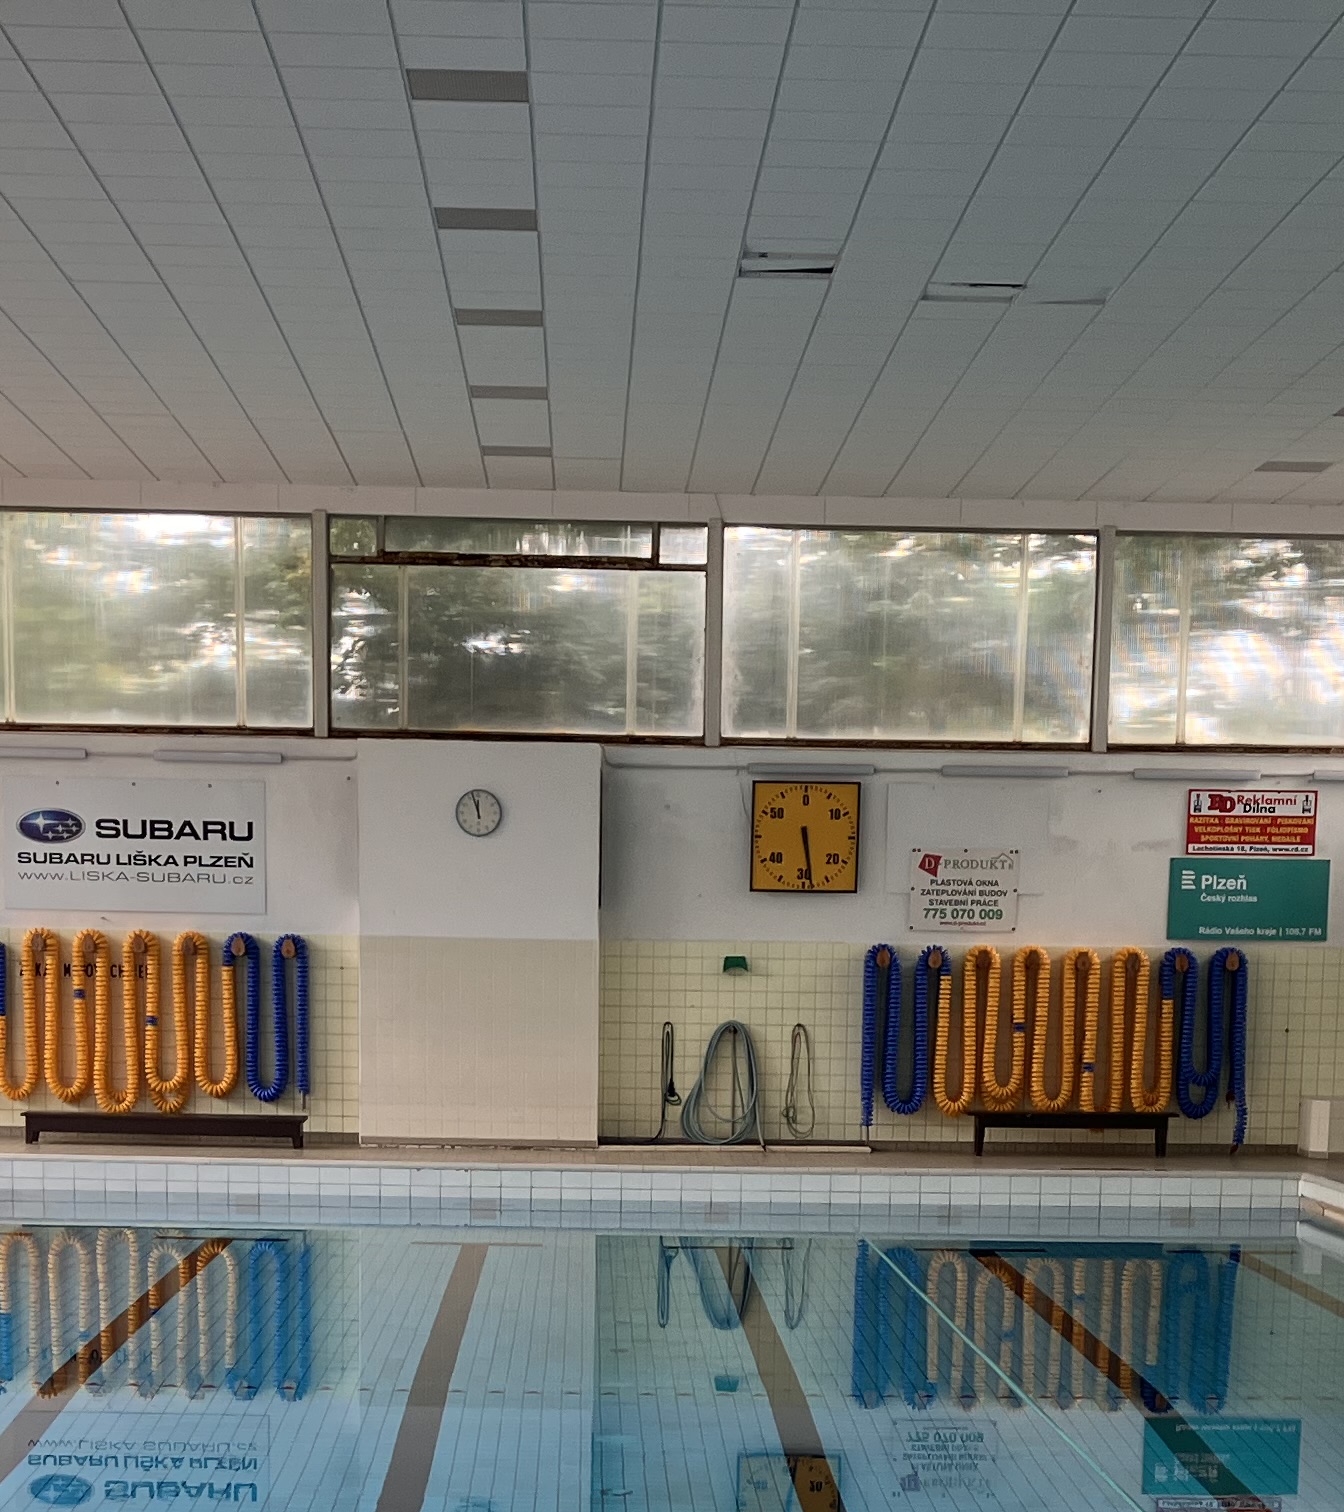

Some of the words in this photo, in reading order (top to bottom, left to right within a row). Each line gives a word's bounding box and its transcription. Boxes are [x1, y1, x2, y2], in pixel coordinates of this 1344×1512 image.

[803, 794, 810, 806] 0
[769, 807, 784, 819] 50
[828, 808, 841, 820] 10
[95, 818, 254, 842] SUBARU
[17, 852, 111, 866] SUBARU
[115, 850, 179, 867] LIŠKA
[183, 852, 254, 868] PLZEŇ
[769, 852, 783, 863] 40
[825, 853, 839, 864] 20
[17, 870, 254, 885] www.LISKA-SUBARU.cz
[797, 868, 811, 880] 30
[930, 878, 973, 887] PLASTOVÁ
[975, 879, 999, 887] OKNA
[1201, 874, 1247, 890] Plzeň
[920, 888, 976, 897] ZATEPLOVÁNÍ
[978, 889, 1008, 897] BUDOV
[928, 898, 968, 907] STAVEBNÍ
[970, 898, 999, 907] PRÁCE
[923, 908, 947, 919] 775
[951, 908, 975, 919] 070
[978, 909, 1003, 920] 009
